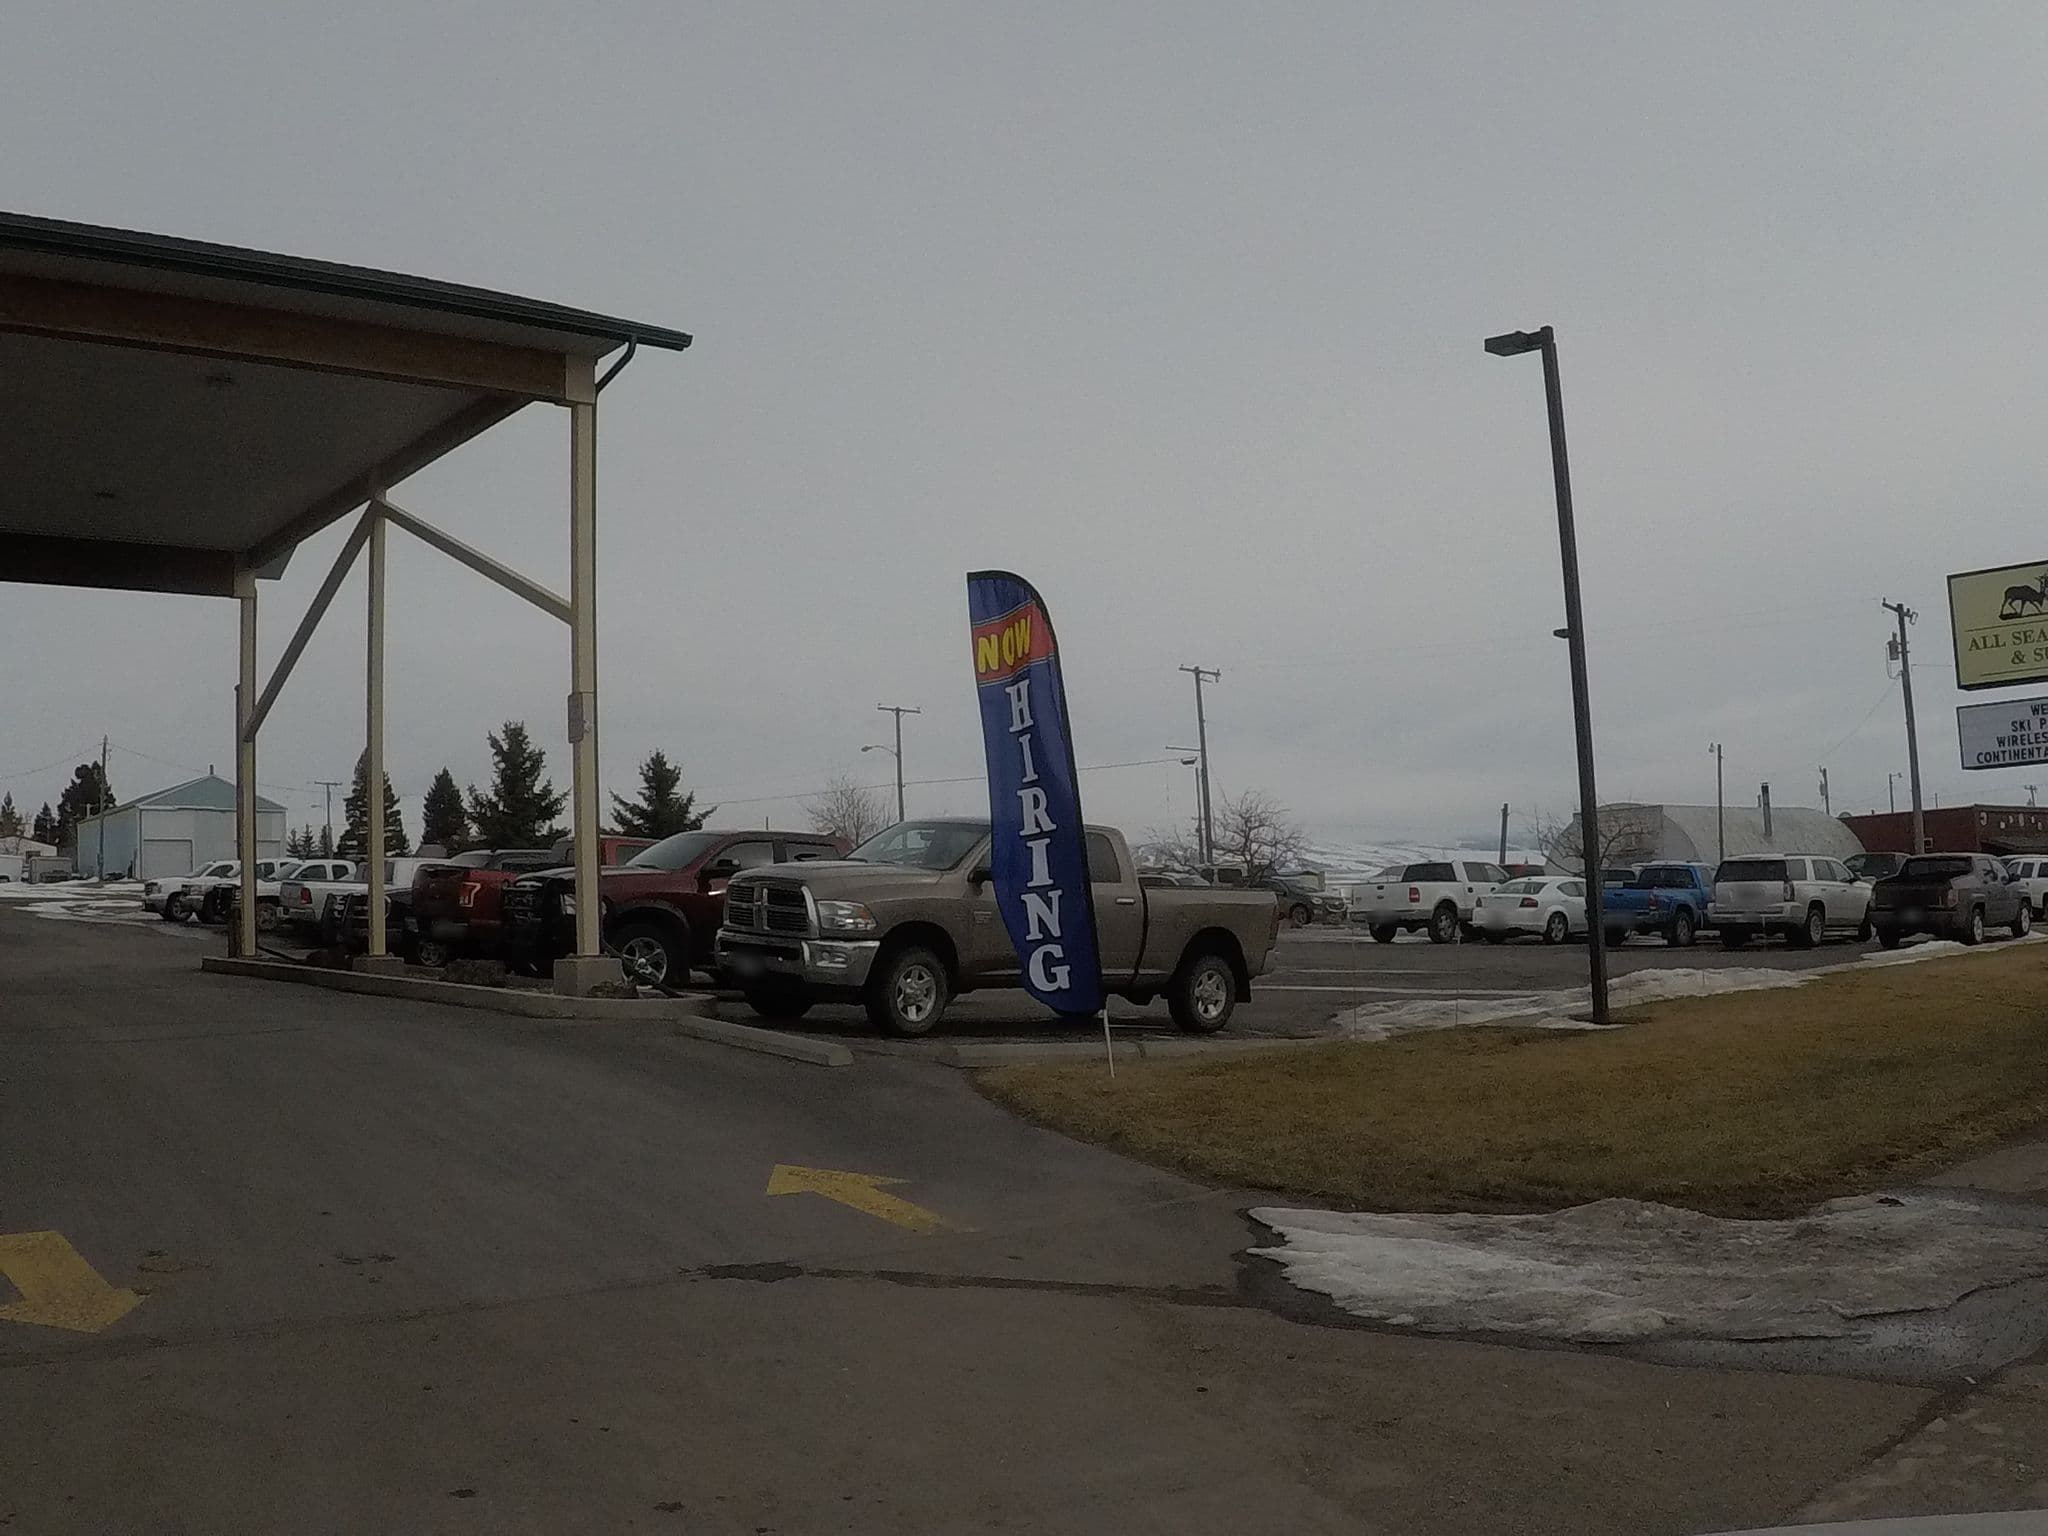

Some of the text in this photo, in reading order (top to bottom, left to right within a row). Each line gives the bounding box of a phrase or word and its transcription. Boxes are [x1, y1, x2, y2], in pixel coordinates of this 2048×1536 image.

[977, 614, 1032, 674] NOW
[1968, 633, 2006, 652] ALL
[2011, 650, 2026, 664] &
[2011, 719, 2031, 732] SKI
[1005, 679, 1071, 993] HIRING
